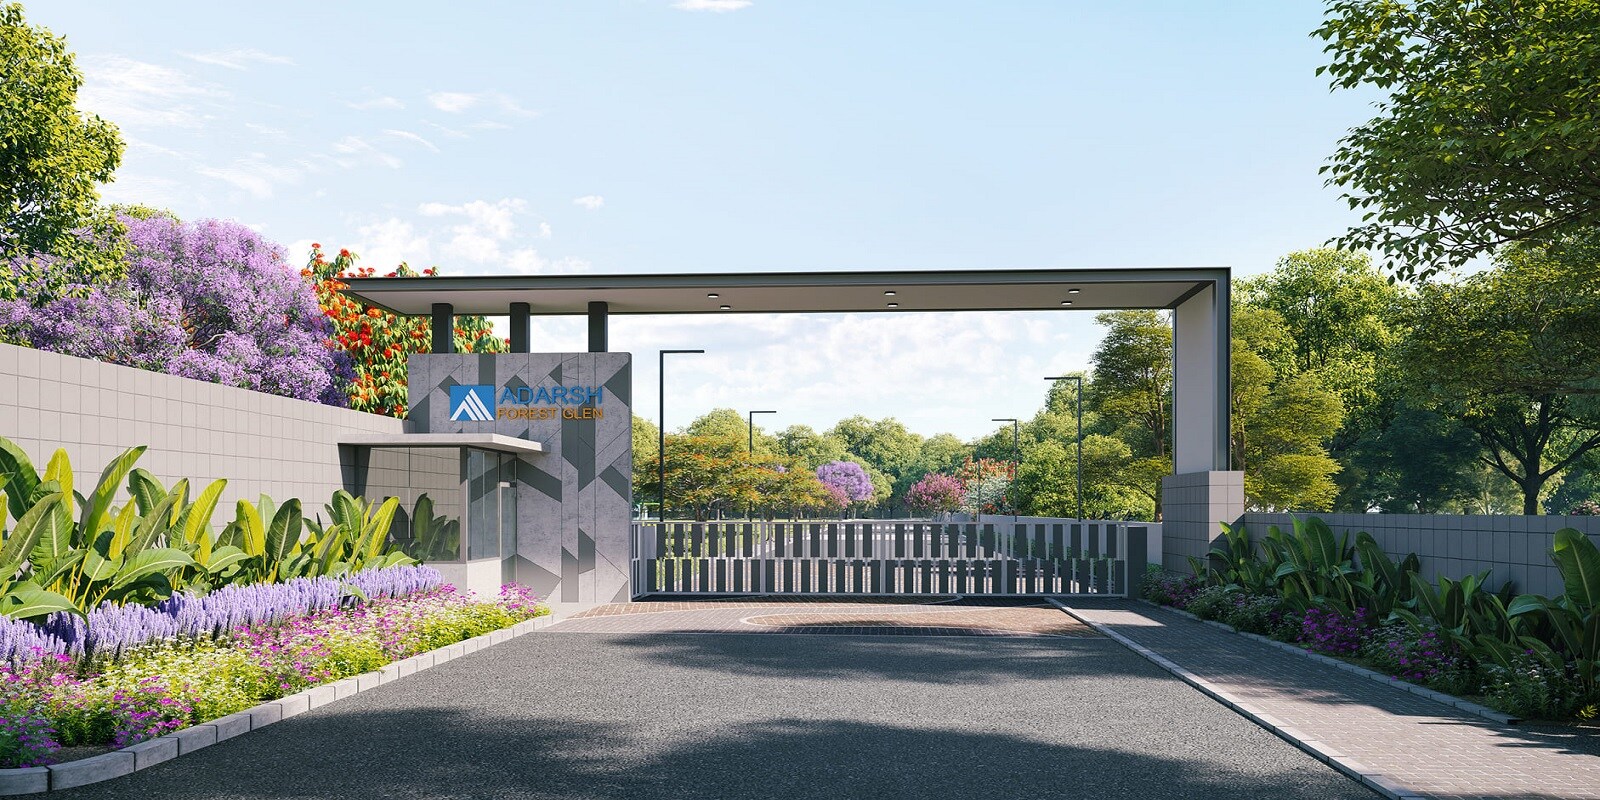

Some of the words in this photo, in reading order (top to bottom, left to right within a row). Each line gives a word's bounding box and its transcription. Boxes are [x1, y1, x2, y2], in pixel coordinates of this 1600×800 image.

[499, 385, 603, 405] ADARSH
[497, 407, 556, 420] FOREST
[562, 407, 604, 420] GLEN
